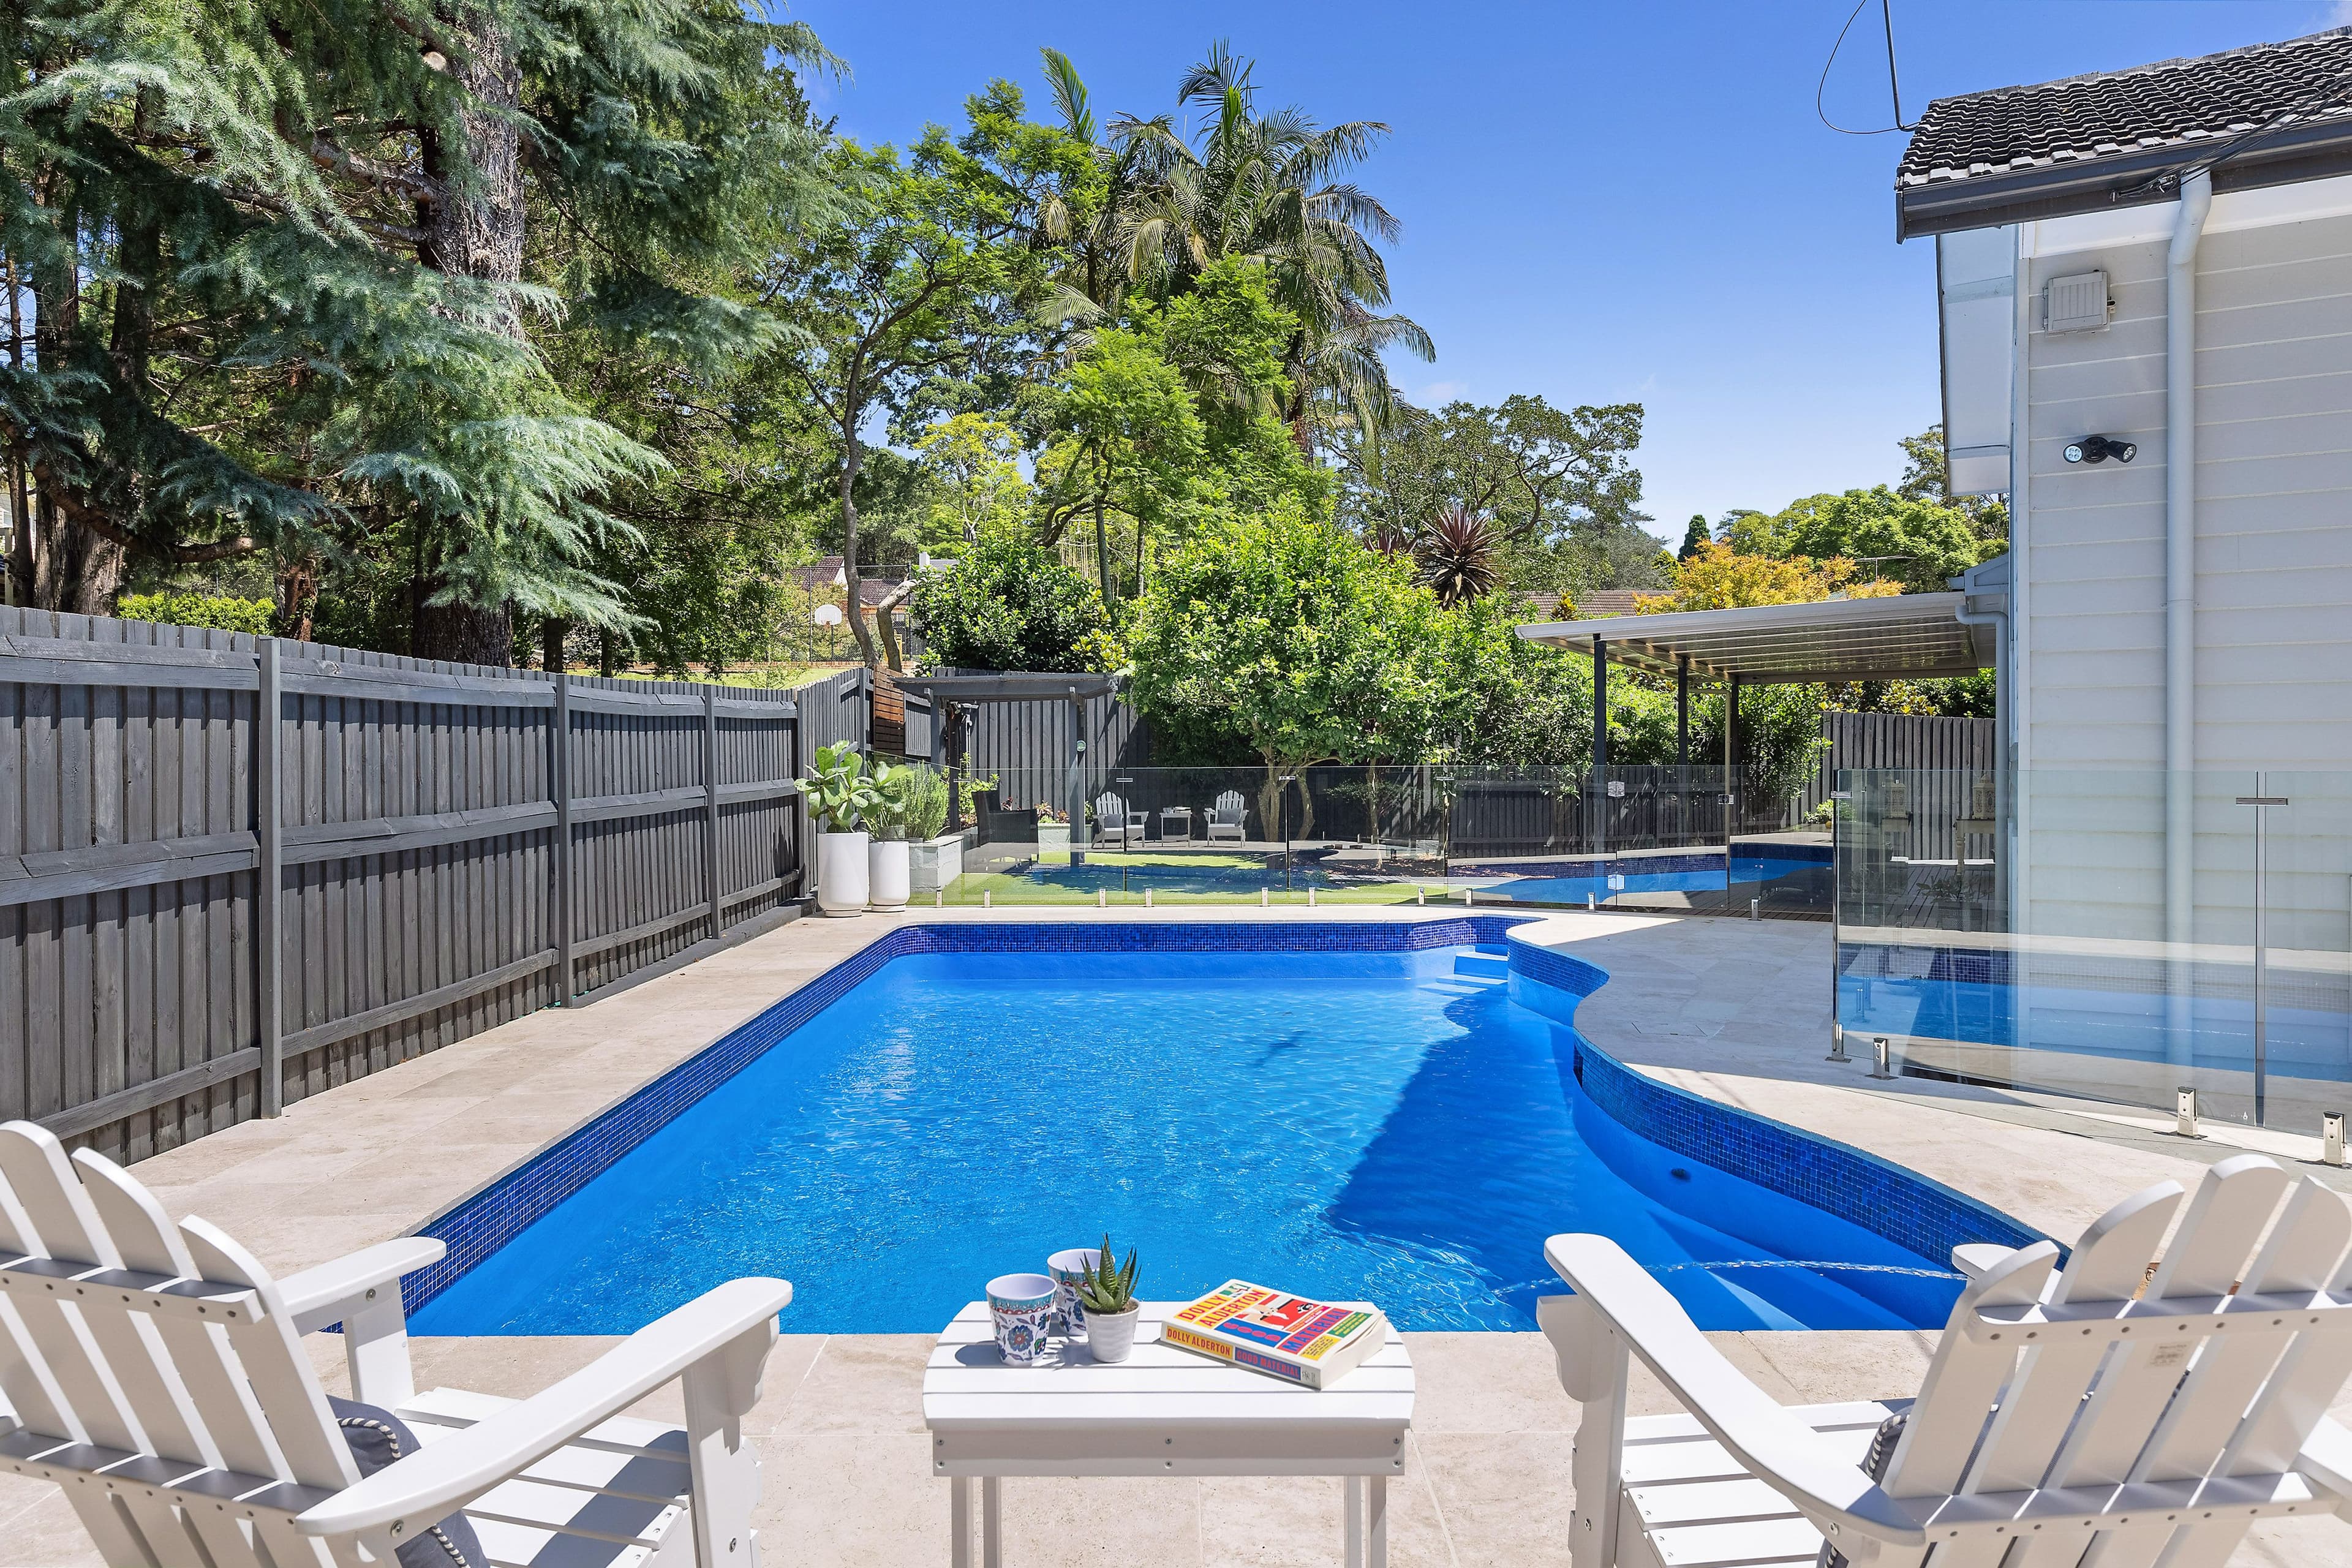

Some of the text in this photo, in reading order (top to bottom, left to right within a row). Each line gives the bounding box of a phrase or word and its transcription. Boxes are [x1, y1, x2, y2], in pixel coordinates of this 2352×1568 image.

[1178, 1295, 1227, 1321] DOLLY
[1199, 1290, 1267, 1326] ALDERTON
[1167, 1329, 1231, 1355] DOLLY ALDERTON
[1223, 1322, 1281, 1341] GOOD
[1282, 1310, 1349, 1352] MATERIAL
[1236, 1351, 1258, 1365] GOOD
[1261, 1358, 1298, 1377] MATERIAL
